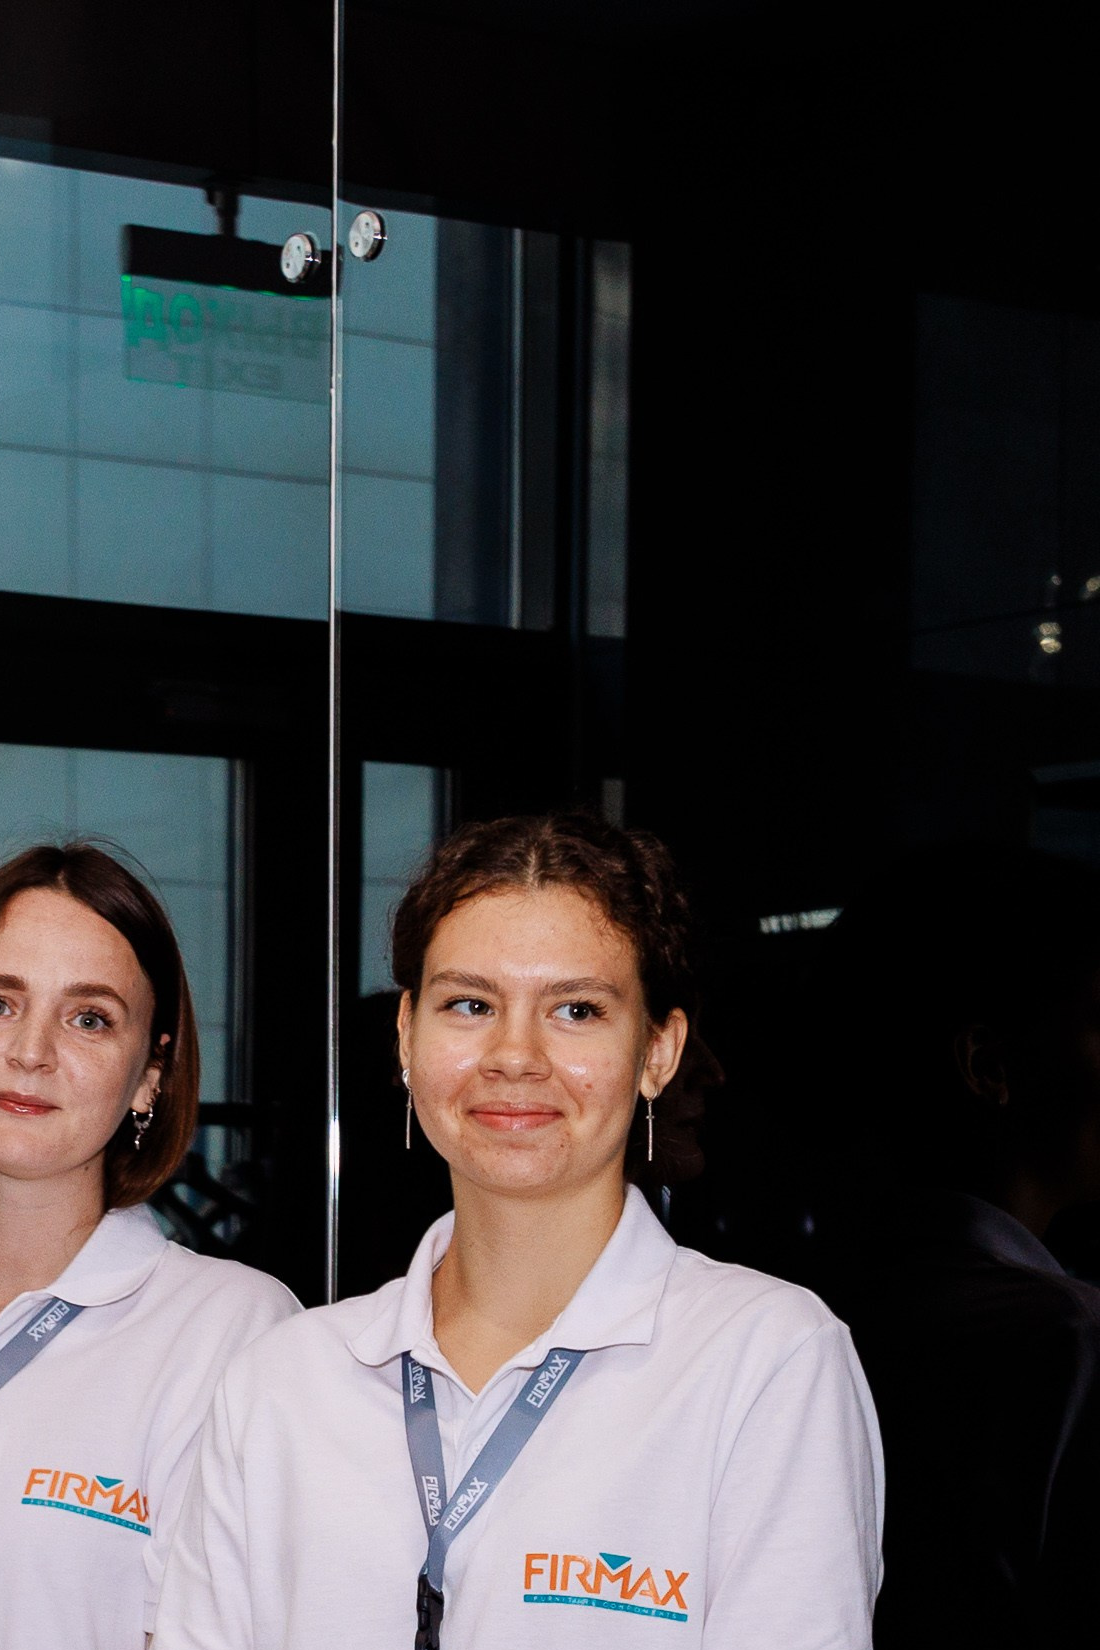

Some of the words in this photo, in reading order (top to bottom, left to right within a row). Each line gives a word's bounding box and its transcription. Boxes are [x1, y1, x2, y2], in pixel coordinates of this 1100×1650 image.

[27, 1300, 70, 1342] FIRMAX
[526, 1354, 571, 1409] FIRMAX
[443, 1476, 489, 1531] FIRMAX
[523, 1552, 690, 1610] FIRMAX
